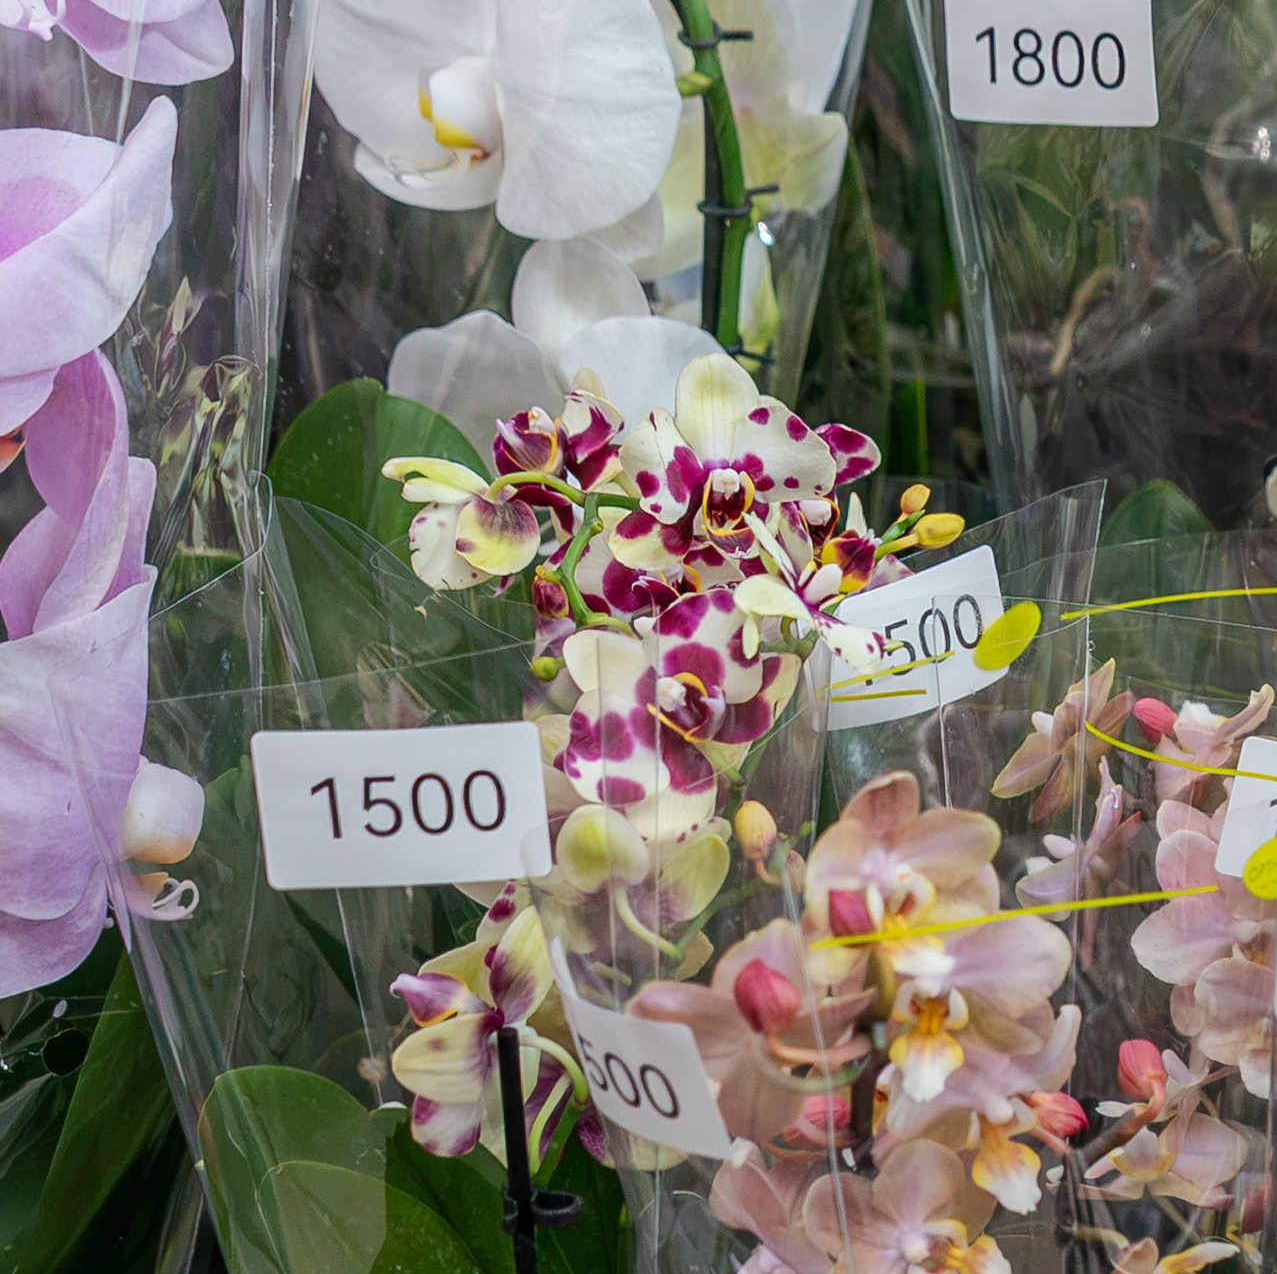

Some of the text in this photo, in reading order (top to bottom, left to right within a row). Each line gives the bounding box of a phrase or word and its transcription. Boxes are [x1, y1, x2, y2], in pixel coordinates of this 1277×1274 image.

[975, 26, 1126, 90] 1800
[865, 594, 982, 686] 500
[310, 769, 507, 839] 1500
